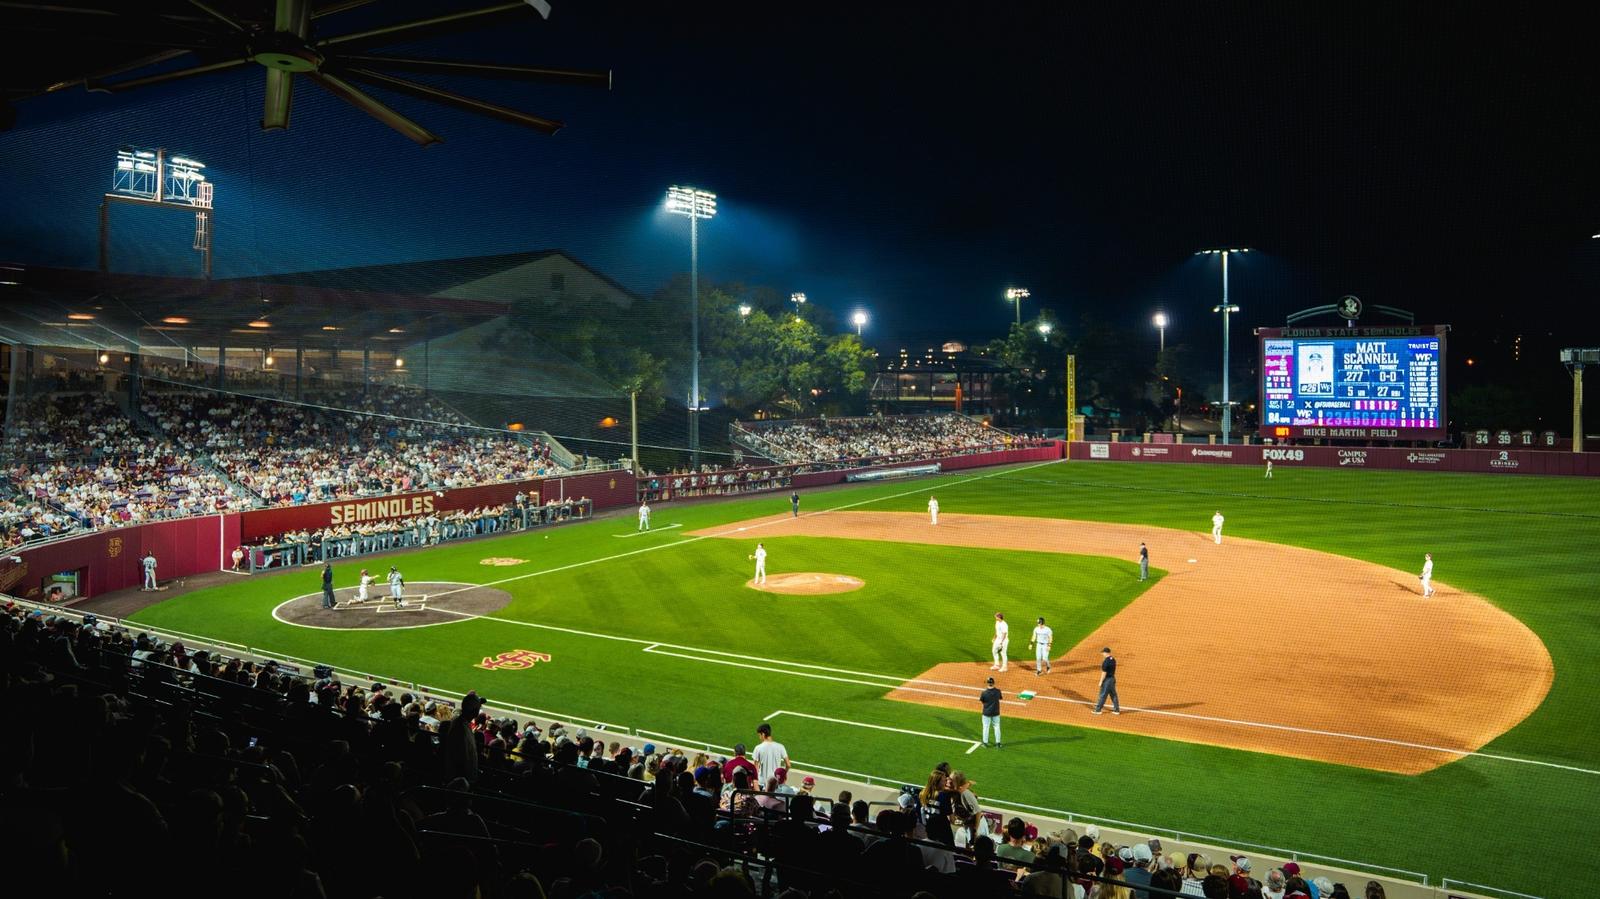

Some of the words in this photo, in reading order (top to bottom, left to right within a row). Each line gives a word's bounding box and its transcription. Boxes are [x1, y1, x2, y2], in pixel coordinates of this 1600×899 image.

[1281, 328, 1321, 337] FLORIDA
[1327, 328, 1358, 337] STATE
[1364, 327, 1422, 336] SEMINOLES
[1356, 342, 1387, 353] MATT
[1344, 353, 1399, 364] SCANNELL
[1415, 353, 1432, 361] WF
[1344, 371, 1364, 381] .277
[1380, 371, 1397, 381] 0-0
[1347, 386, 1354, 396] 5
[1377, 386, 1389, 396] 27
[1303, 428, 1327, 437] MIKE
[1330, 428, 1366, 437] MARTIN
[1371, 429, 1398, 437] FIELD
[1475, 435, 1489, 444] 34
[1522, 435, 1532, 445] 11
[1546, 436, 1555, 446] 8
[1338, 450, 1367, 459] CAMPUS
[330, 495, 434, 525] SEMINOLES
